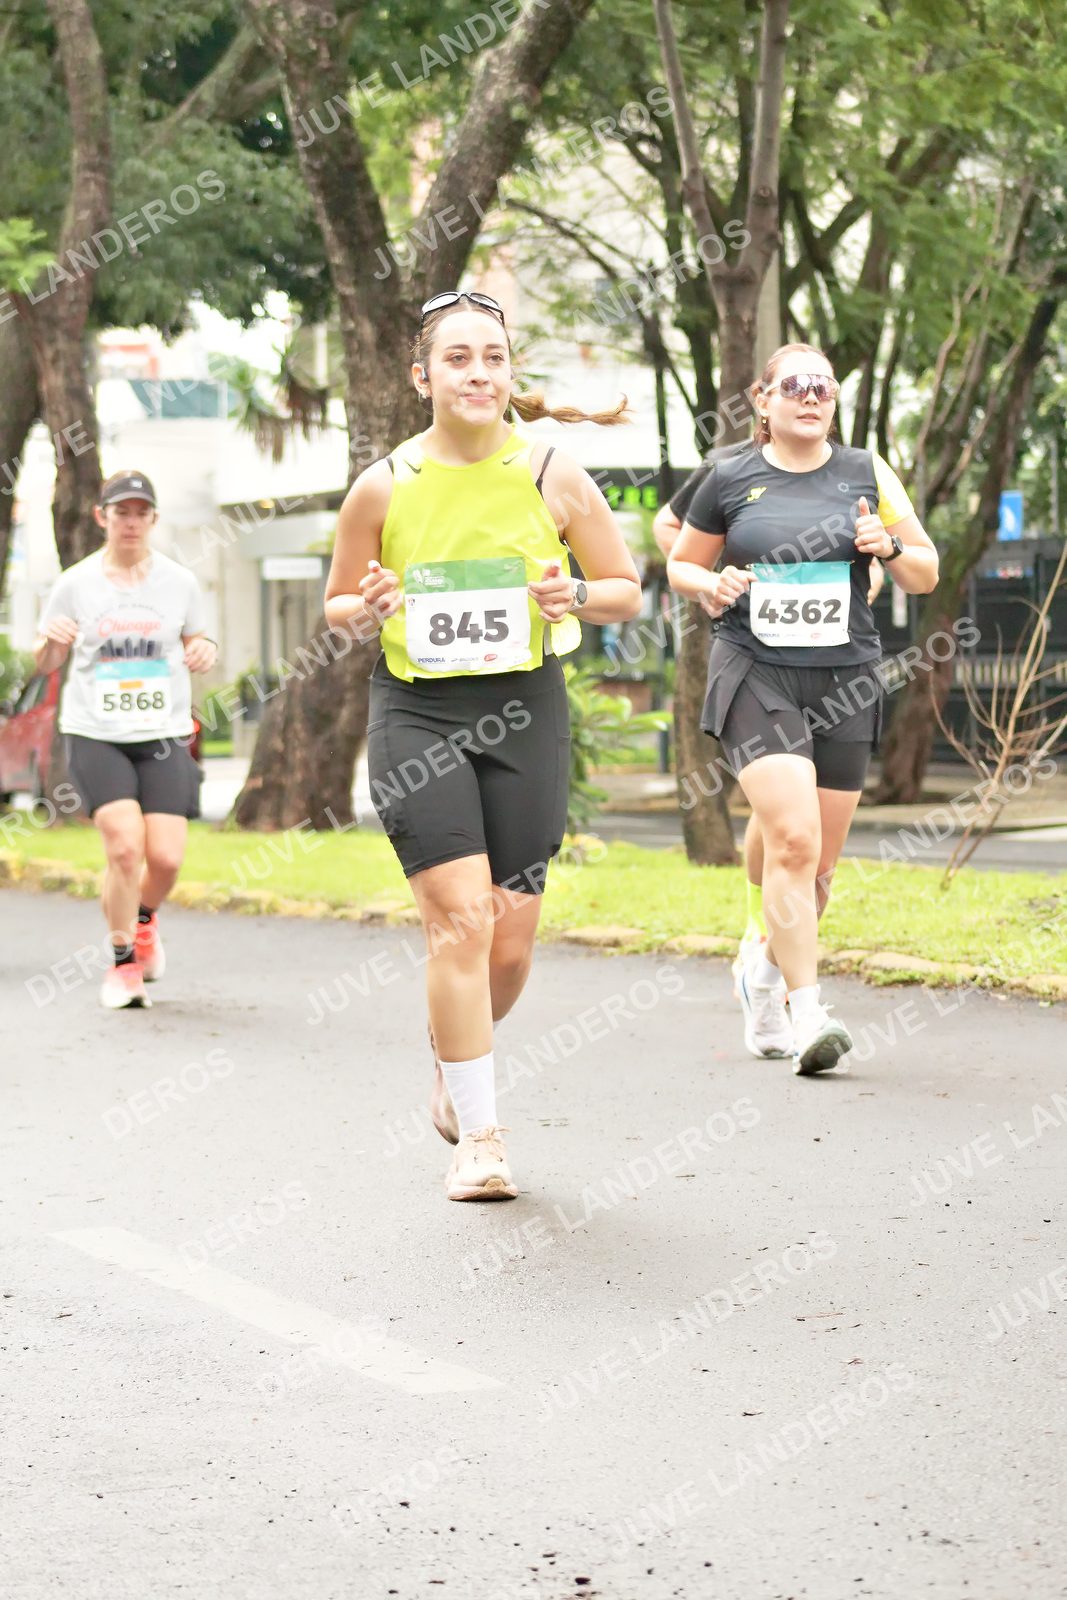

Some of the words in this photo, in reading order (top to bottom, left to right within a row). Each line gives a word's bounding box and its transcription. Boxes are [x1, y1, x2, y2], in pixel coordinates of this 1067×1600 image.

[757, 598, 842, 625] 4362
[98, 617, 162, 638] Chicago
[429, 609, 509, 646] 845
[103, 691, 165, 712] 5868
